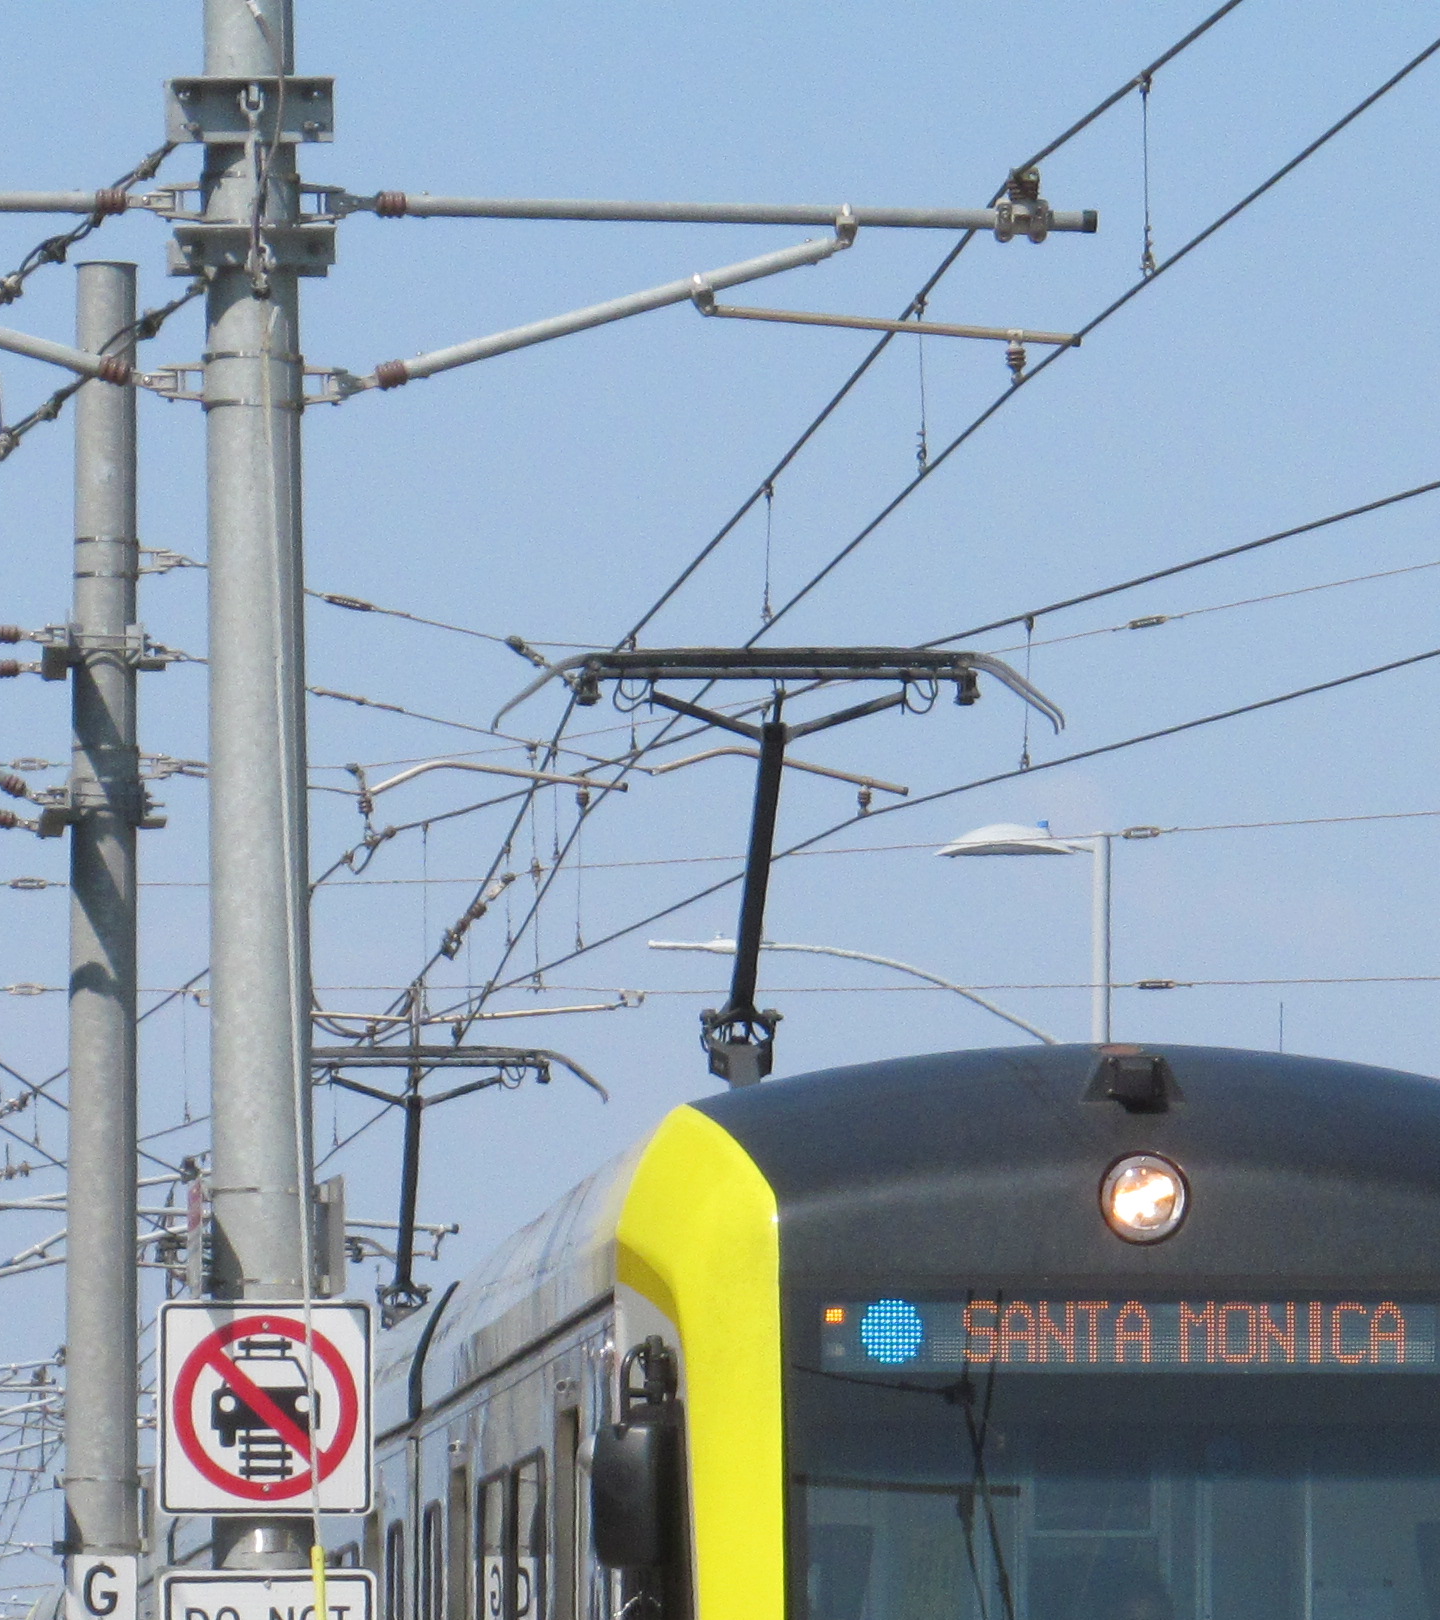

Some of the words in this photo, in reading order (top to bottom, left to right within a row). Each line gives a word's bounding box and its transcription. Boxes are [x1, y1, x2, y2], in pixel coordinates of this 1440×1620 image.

[963, 1301, 1152, 1363] SANTA
[1179, 1301, 1406, 1363] MONICA
[83, 1564, 118, 1616] G
